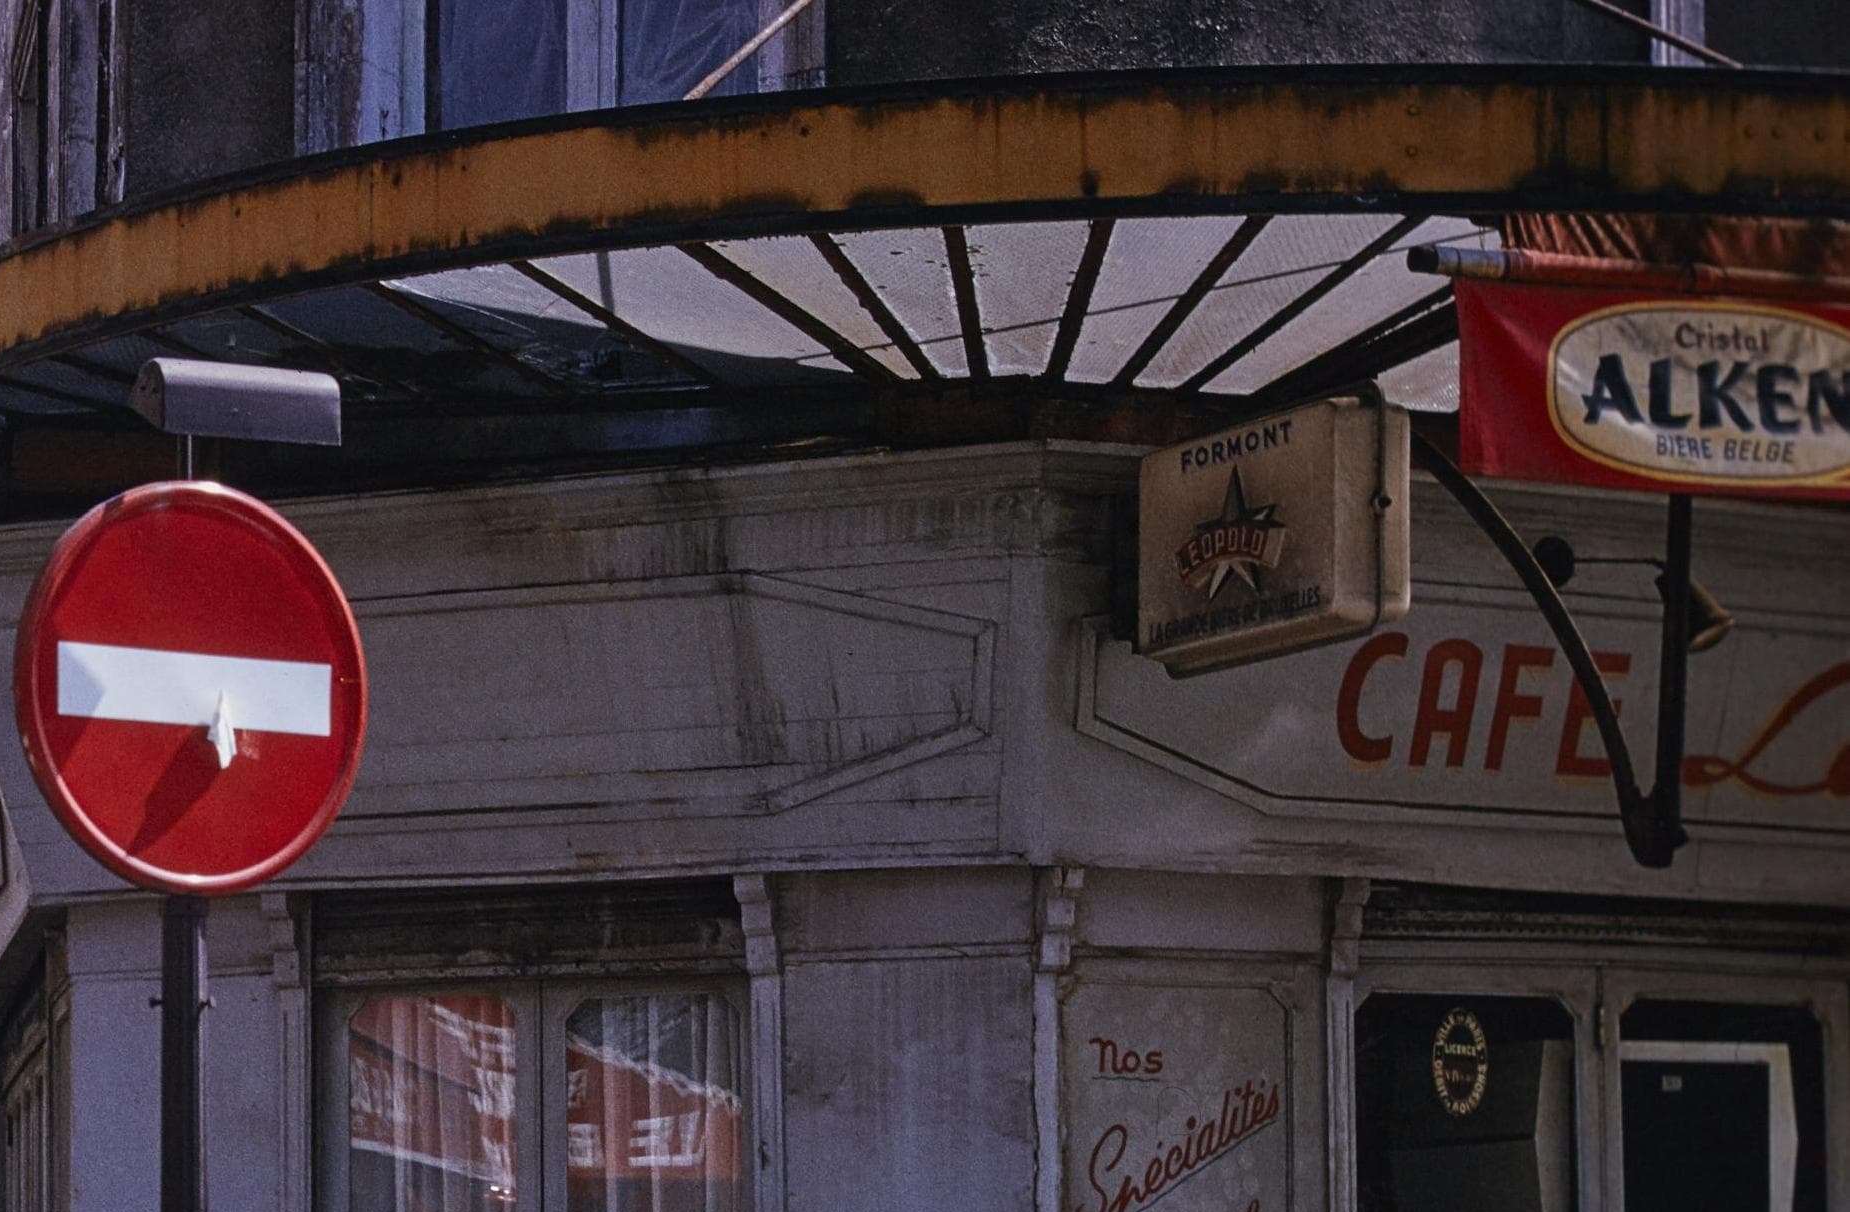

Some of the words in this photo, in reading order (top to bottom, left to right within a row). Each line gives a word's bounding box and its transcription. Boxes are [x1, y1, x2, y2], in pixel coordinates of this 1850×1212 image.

[1675, 323, 1770, 351] Cristal
[1582, 353, 1850, 433] ALKEN
[1181, 420, 1293, 474] FORMONT
[1724, 439, 1796, 463] BELGE
[1090, 1037, 1164, 1074] Nos
